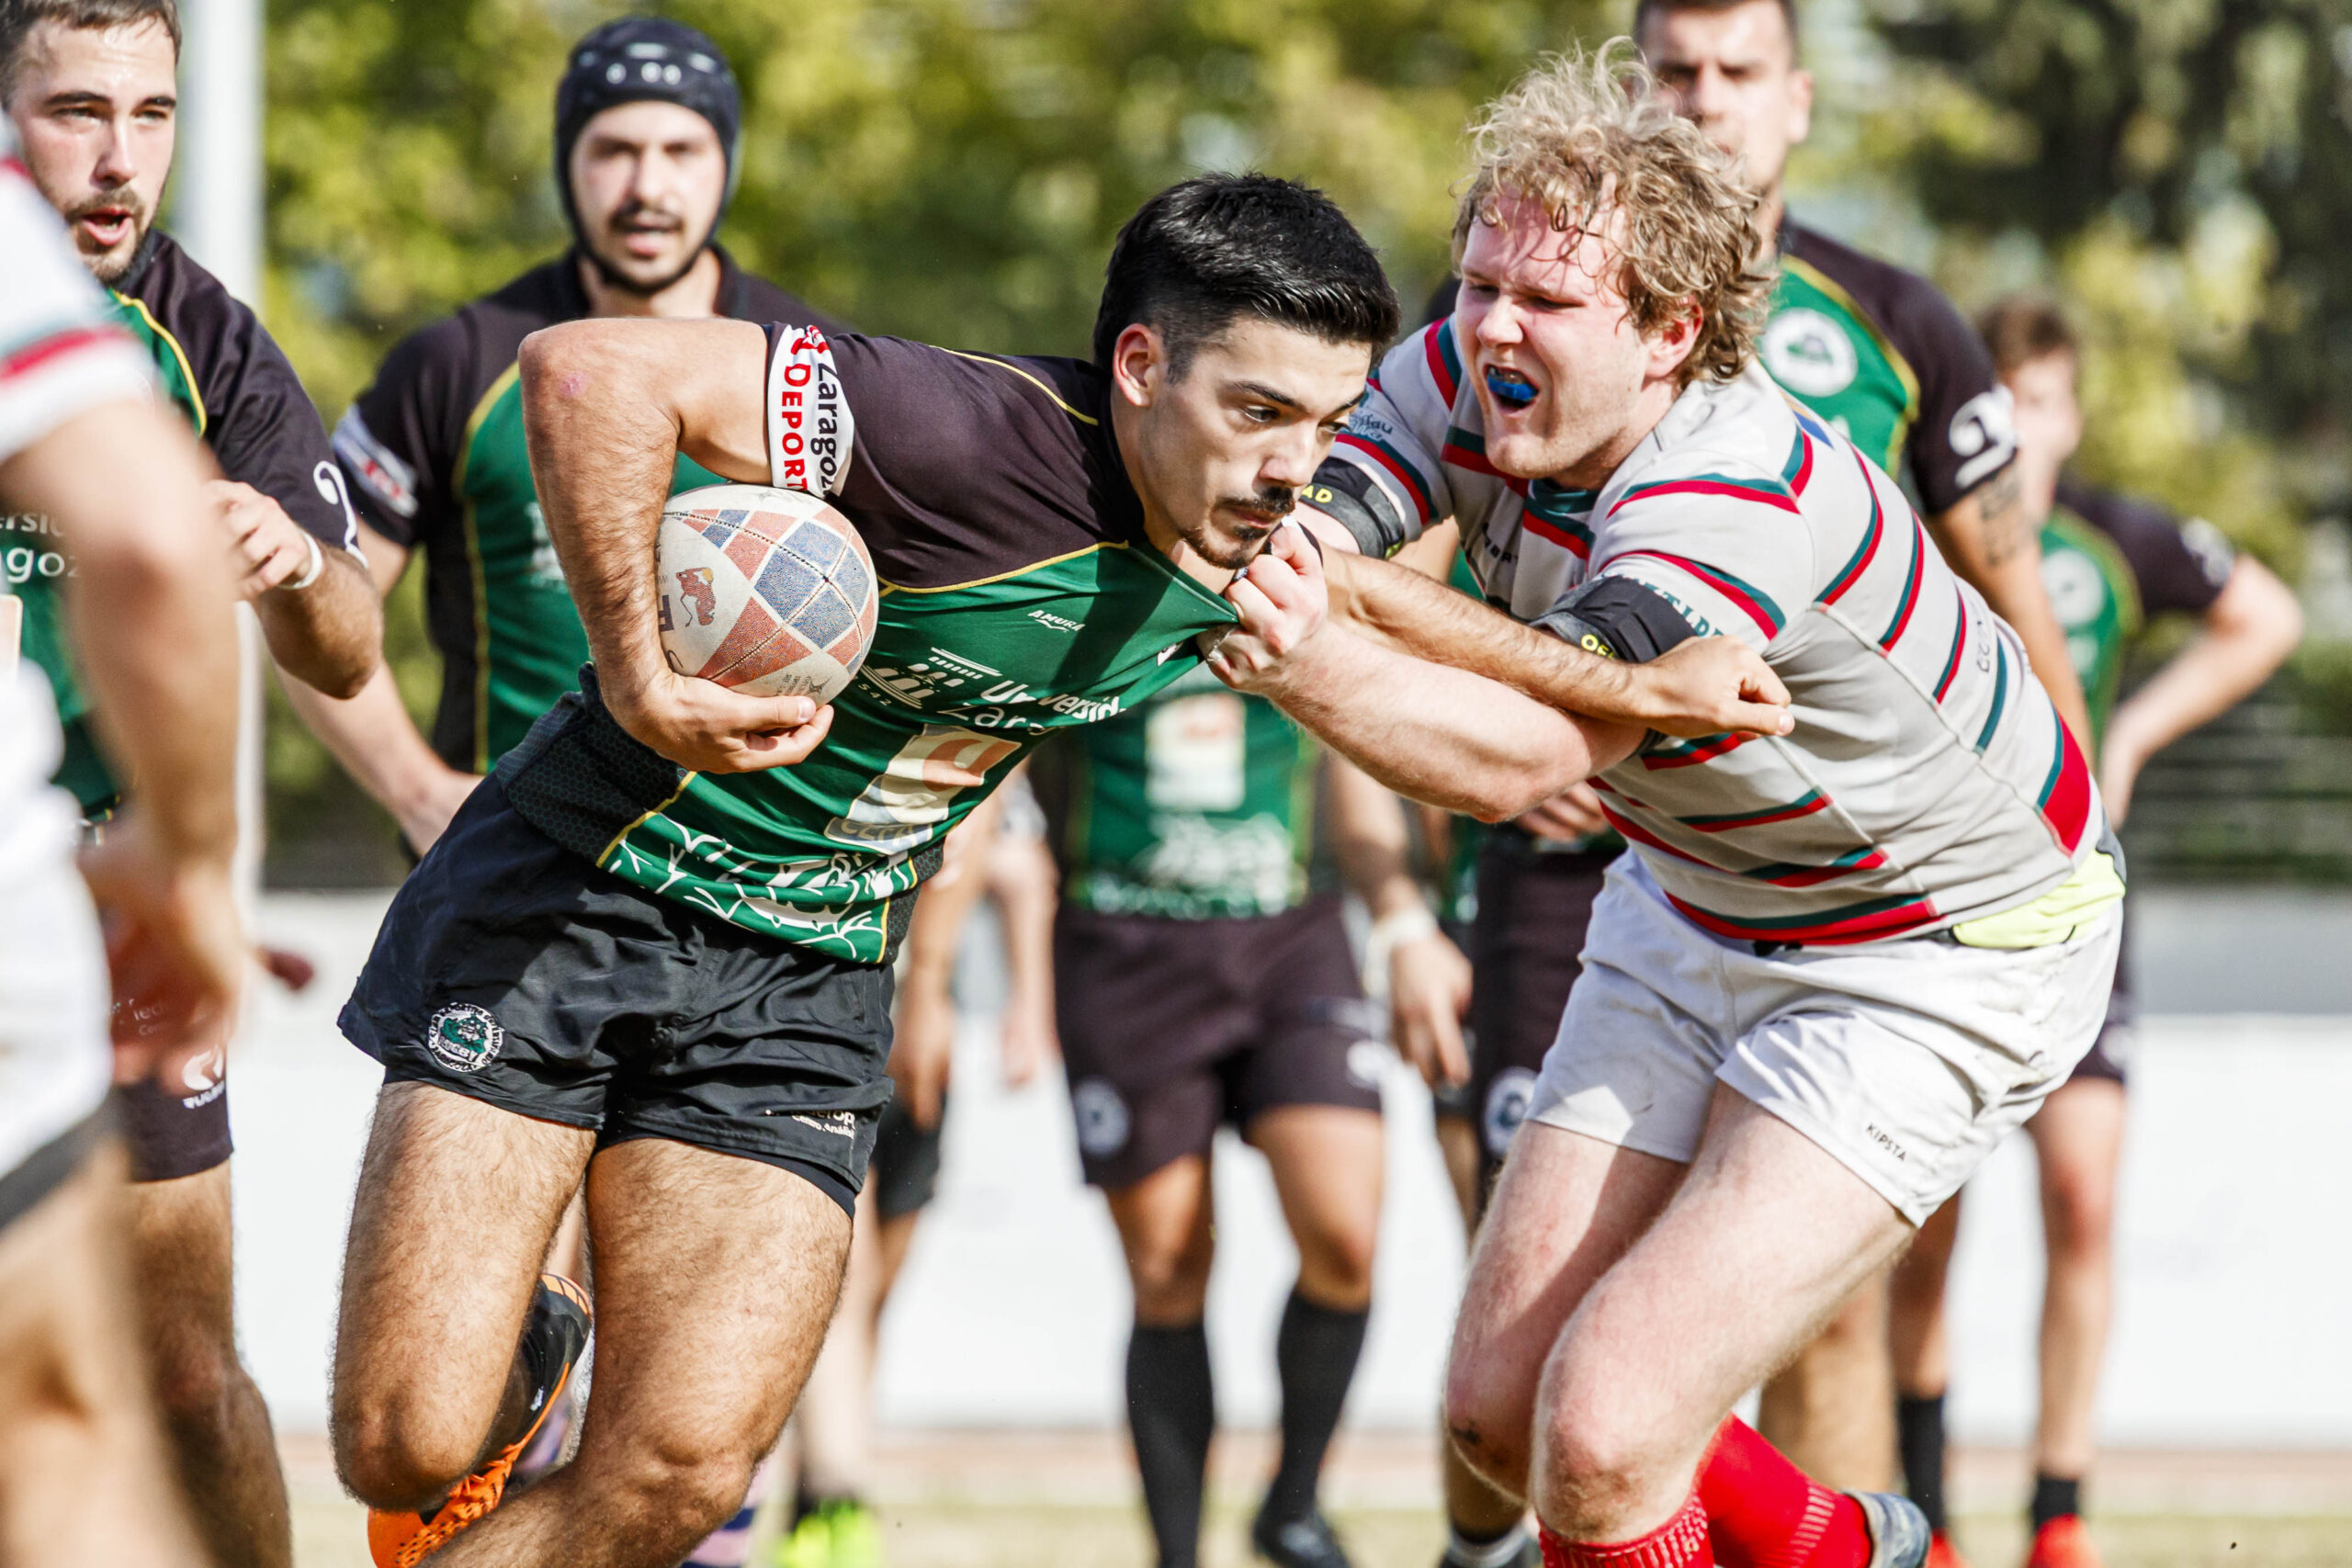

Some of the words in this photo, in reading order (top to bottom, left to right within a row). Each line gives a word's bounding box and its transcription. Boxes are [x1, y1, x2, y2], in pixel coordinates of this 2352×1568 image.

[810, 363, 838, 497] Zaragoz
[1027, 610, 1086, 631] AMURA
[1866, 1123, 1906, 1162] KIPSTA
